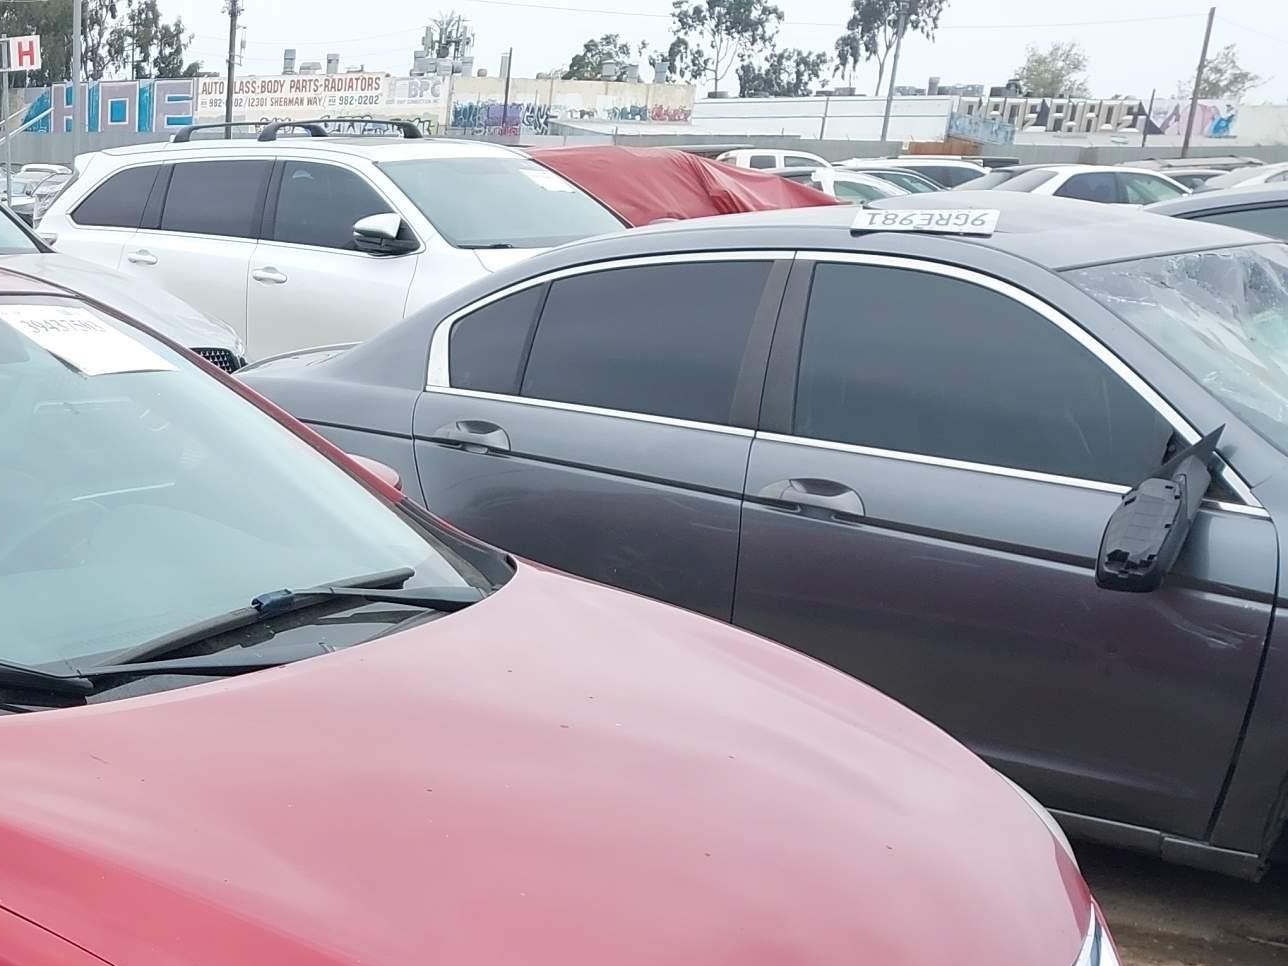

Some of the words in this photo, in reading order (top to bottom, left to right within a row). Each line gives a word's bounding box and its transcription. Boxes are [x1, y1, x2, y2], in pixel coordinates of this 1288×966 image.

[17, 40, 35, 66] H
[201, 81, 225, 95] AUTO
[270, 96, 304, 107] SHERMAN
